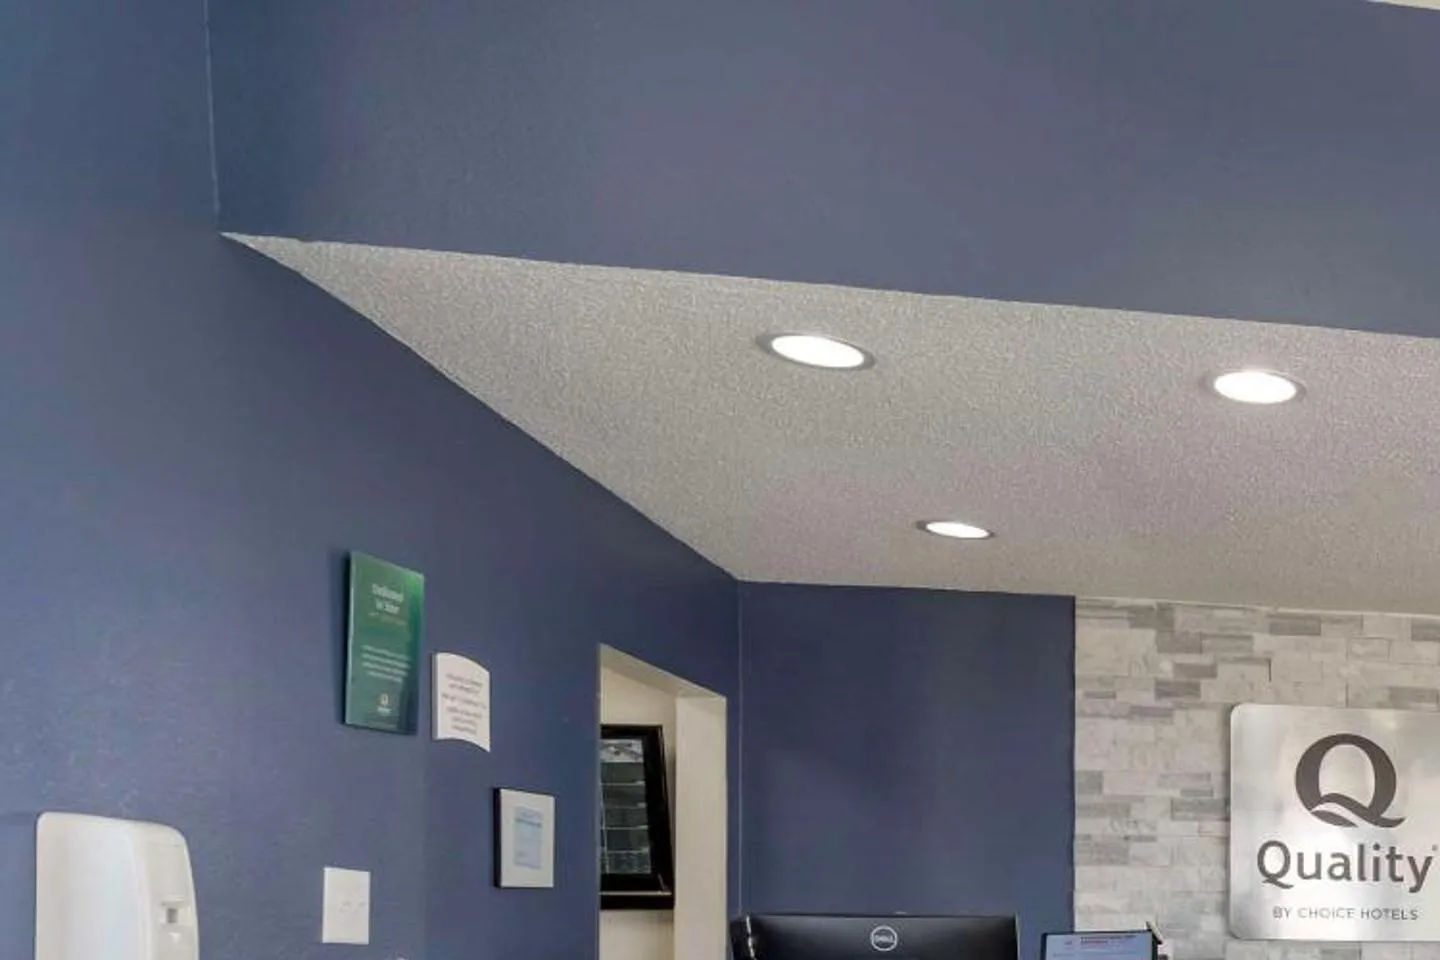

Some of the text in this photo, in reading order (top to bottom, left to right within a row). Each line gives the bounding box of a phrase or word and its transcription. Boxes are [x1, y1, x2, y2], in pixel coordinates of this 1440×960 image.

[1295, 733, 1406, 828] Q
[1257, 840, 1433, 893] Quality
[1272, 906, 1418, 921] BY CHOICE HOTELS
